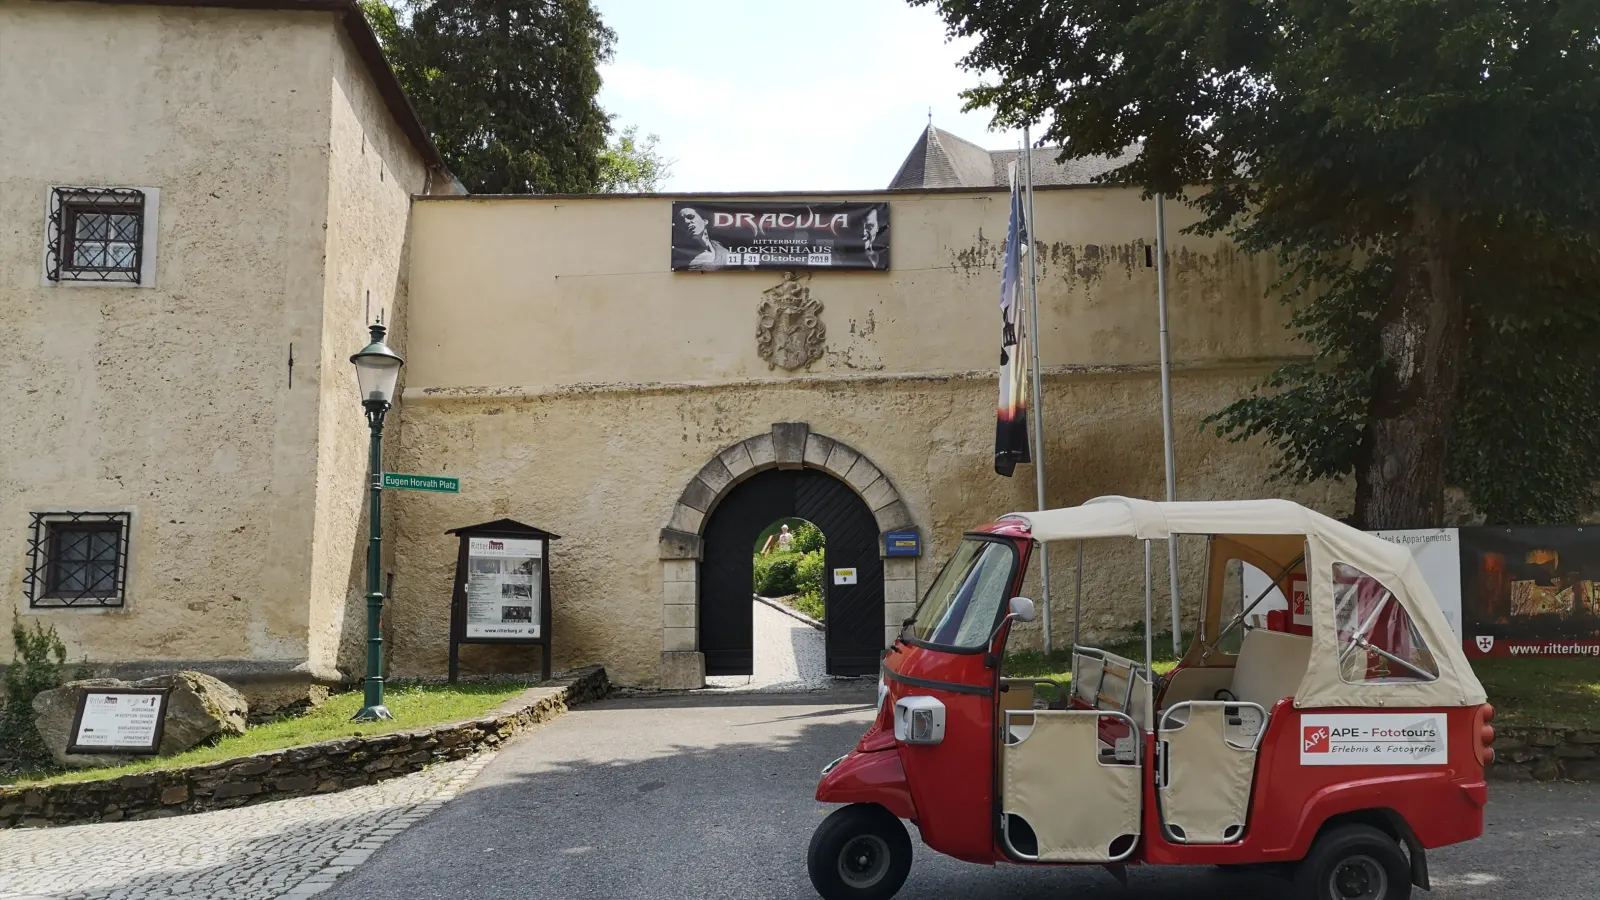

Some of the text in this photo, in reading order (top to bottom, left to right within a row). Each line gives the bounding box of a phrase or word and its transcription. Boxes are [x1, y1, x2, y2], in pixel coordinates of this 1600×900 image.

[713, 205, 849, 237] DRACULA
[729, 246, 832, 254] LOCKENHAUS
[385, 476, 455, 489] Eugen Horvath Platz
[1396, 536, 1401, 544] &
[1402, 532, 1452, 545] Appartements
[1331, 728, 1359, 738] APE
[1371, 728, 1436, 738] Fototours
[1304, 728, 1328, 752] APE
[1331, 744, 1436, 755] Erlebnis & Fotografie
